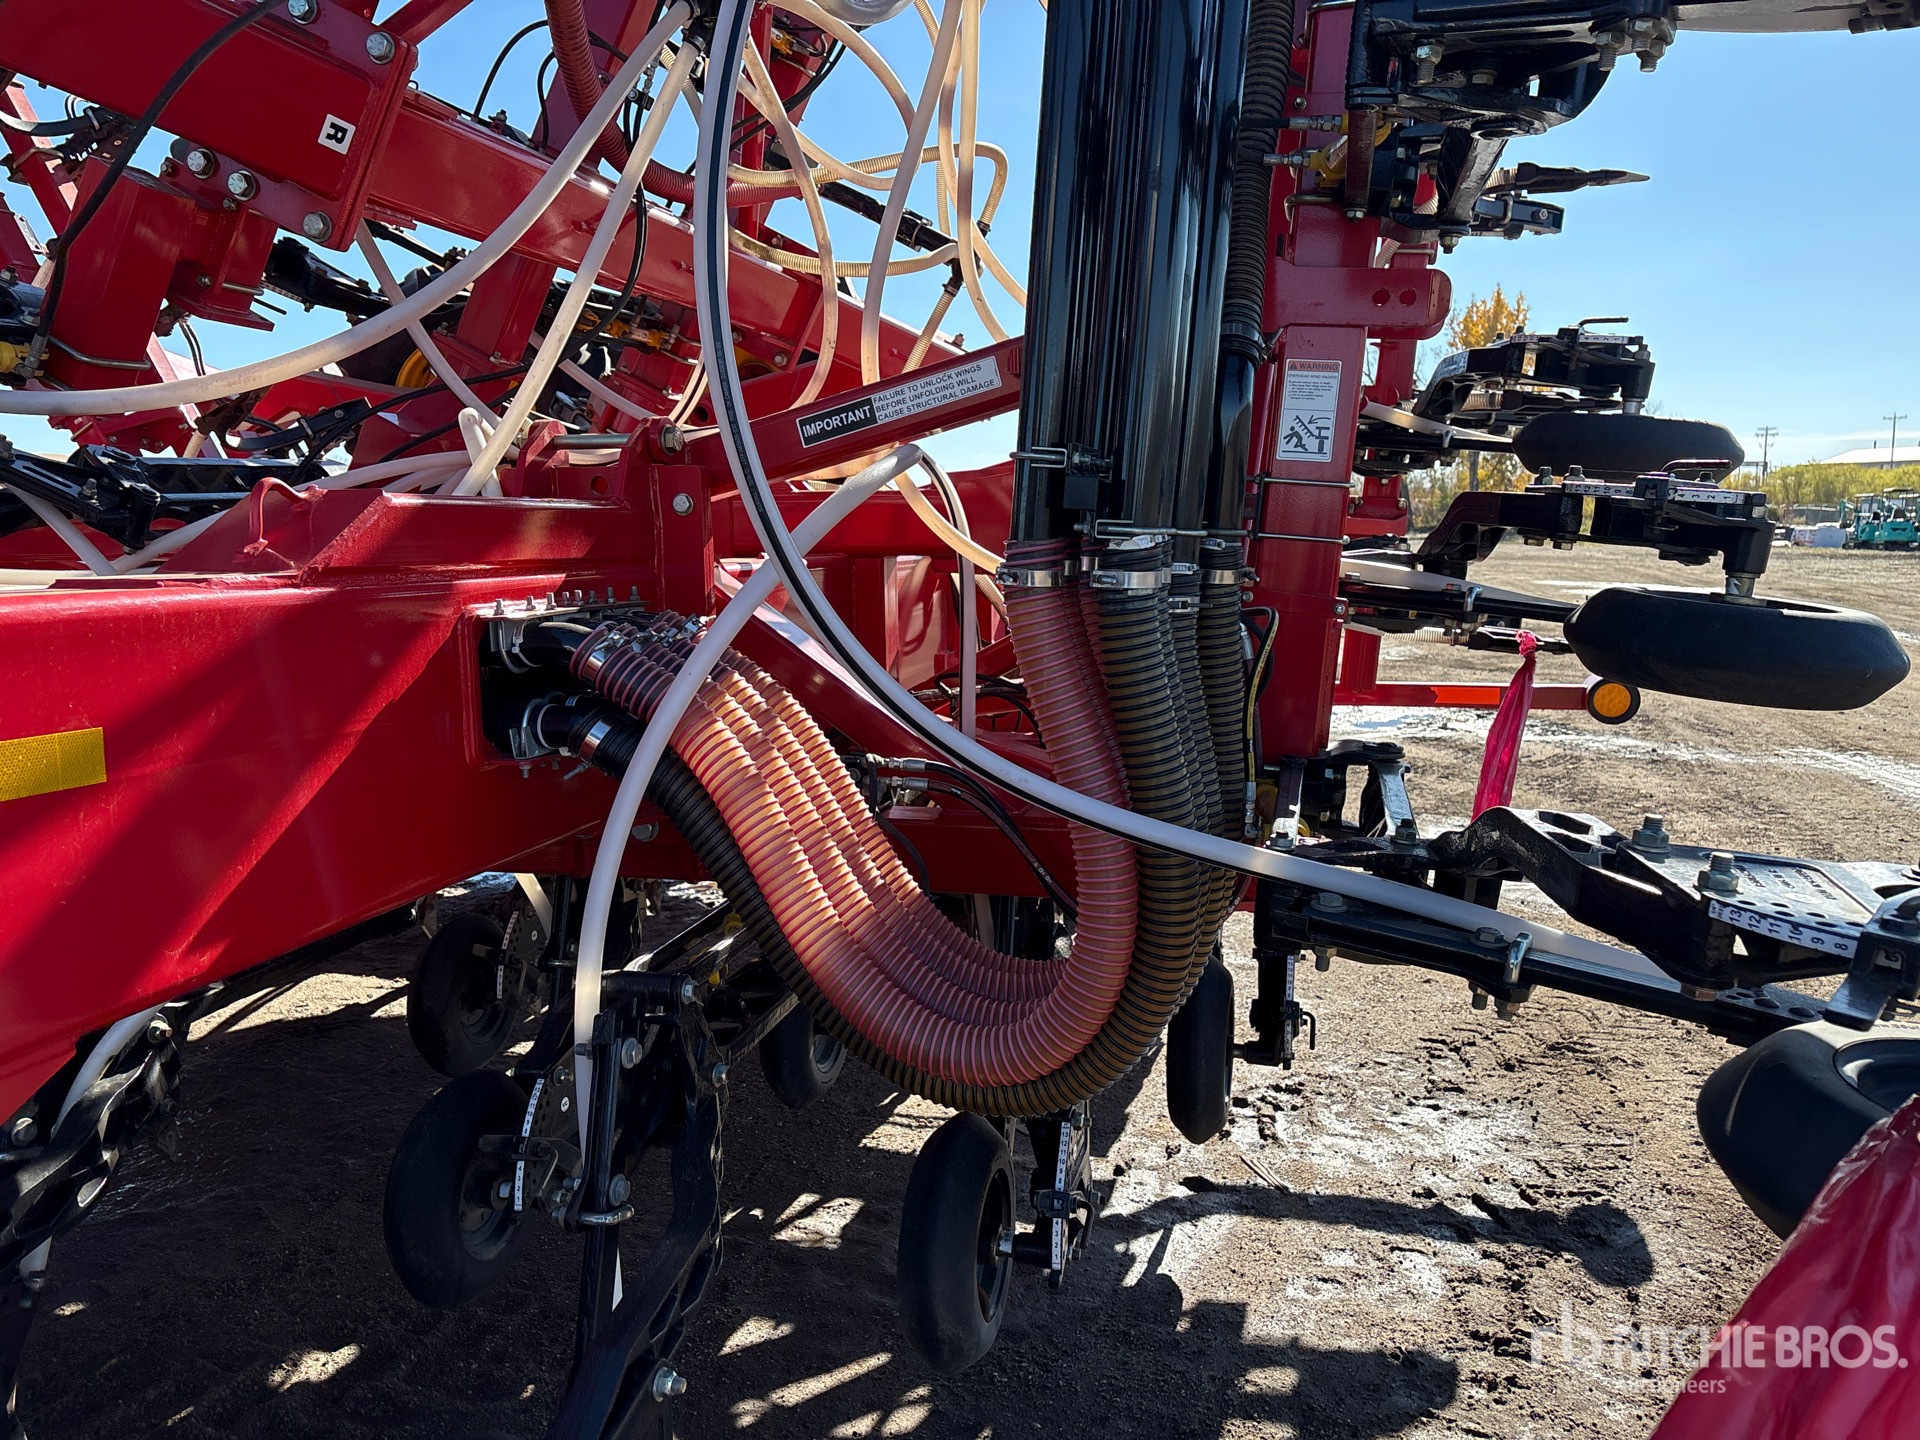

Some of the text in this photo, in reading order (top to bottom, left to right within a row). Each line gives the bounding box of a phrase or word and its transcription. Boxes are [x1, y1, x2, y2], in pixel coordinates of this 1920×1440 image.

[325, 121, 349, 145] R
[1299, 362, 1338, 371] WARNING
[873, 364, 982, 404] FAILURE TO UNLOCK WINGS
[876, 376, 976, 413] BEFORE UNFOLDING WILL
[878, 407, 904, 422] CAUSE
[907, 391, 959, 413] STRUCTURAL
[802, 405, 871, 437] IMPORTANT
[1729, 909, 1742, 923] 13
[1748, 915, 1761, 929] 12
[1768, 922, 1782, 935] 11
[1788, 926, 1803, 941] 10
[1811, 936, 1825, 946] 9
[1834, 942, 1848, 951] 8
